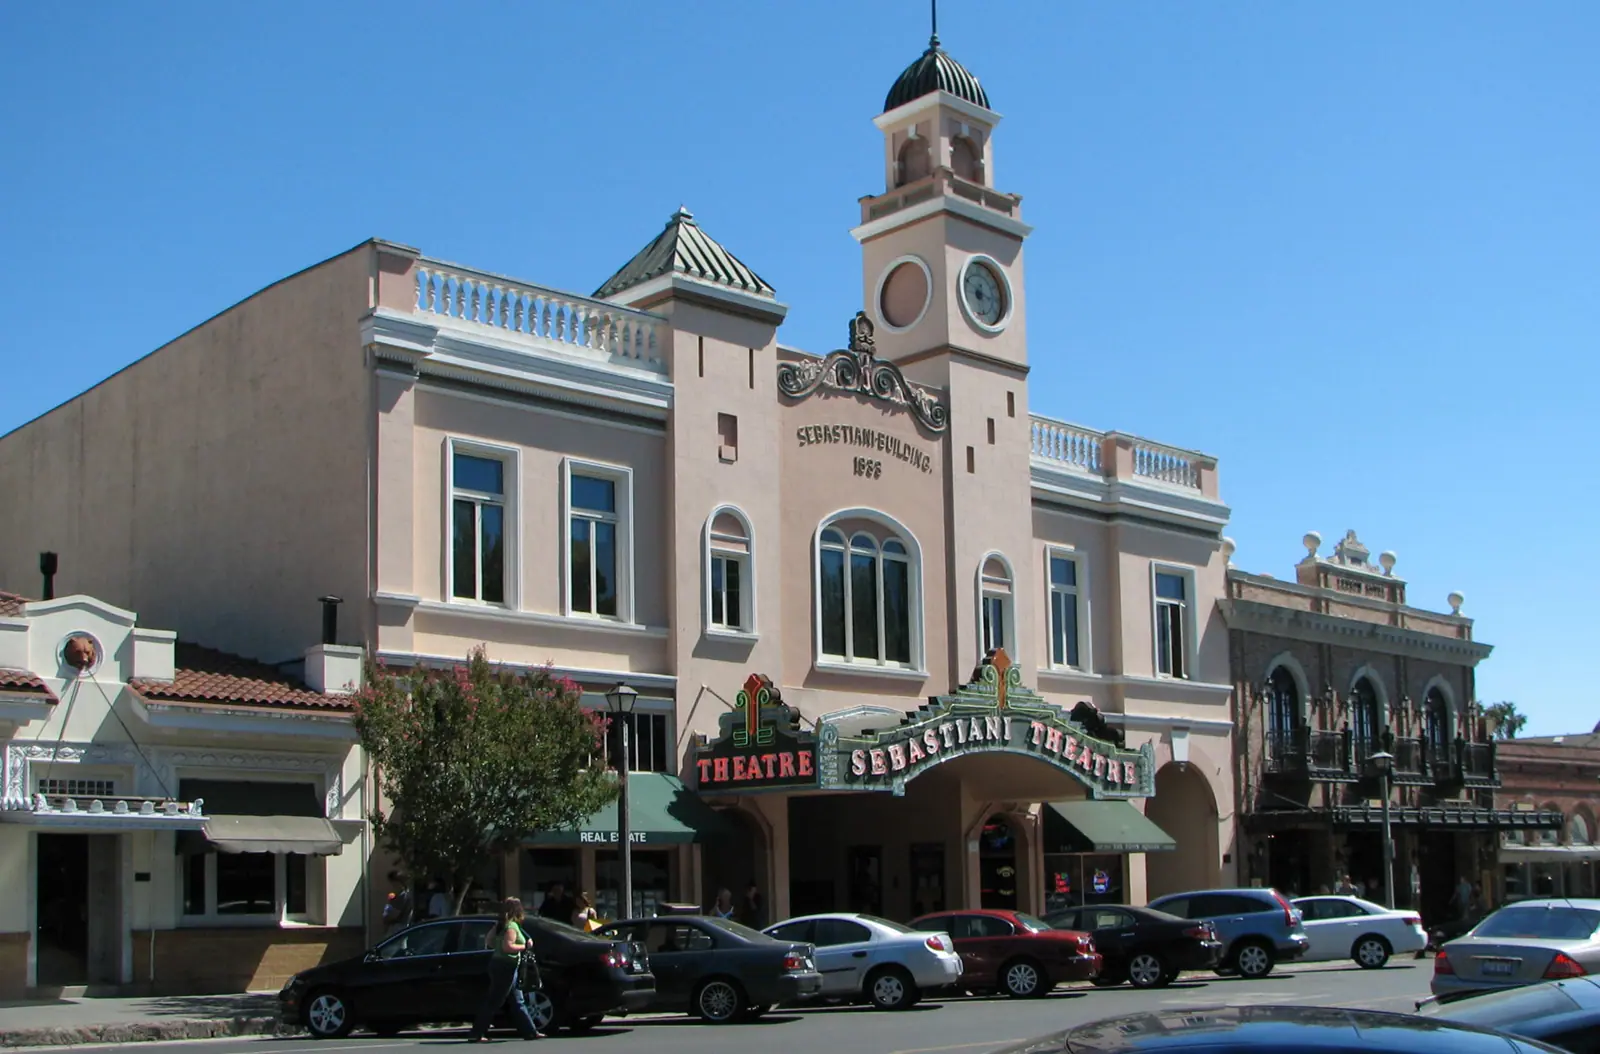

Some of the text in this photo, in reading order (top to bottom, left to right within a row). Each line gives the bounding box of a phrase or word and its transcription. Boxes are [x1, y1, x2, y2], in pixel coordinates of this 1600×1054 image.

[796, 424, 875, 449] SEBASTIANI
[851, 716, 1137, 784] SEBASTIANI THEATRE
[696, 750, 814, 783] THEATRE
[580, 831, 647, 843] REAL EATE
